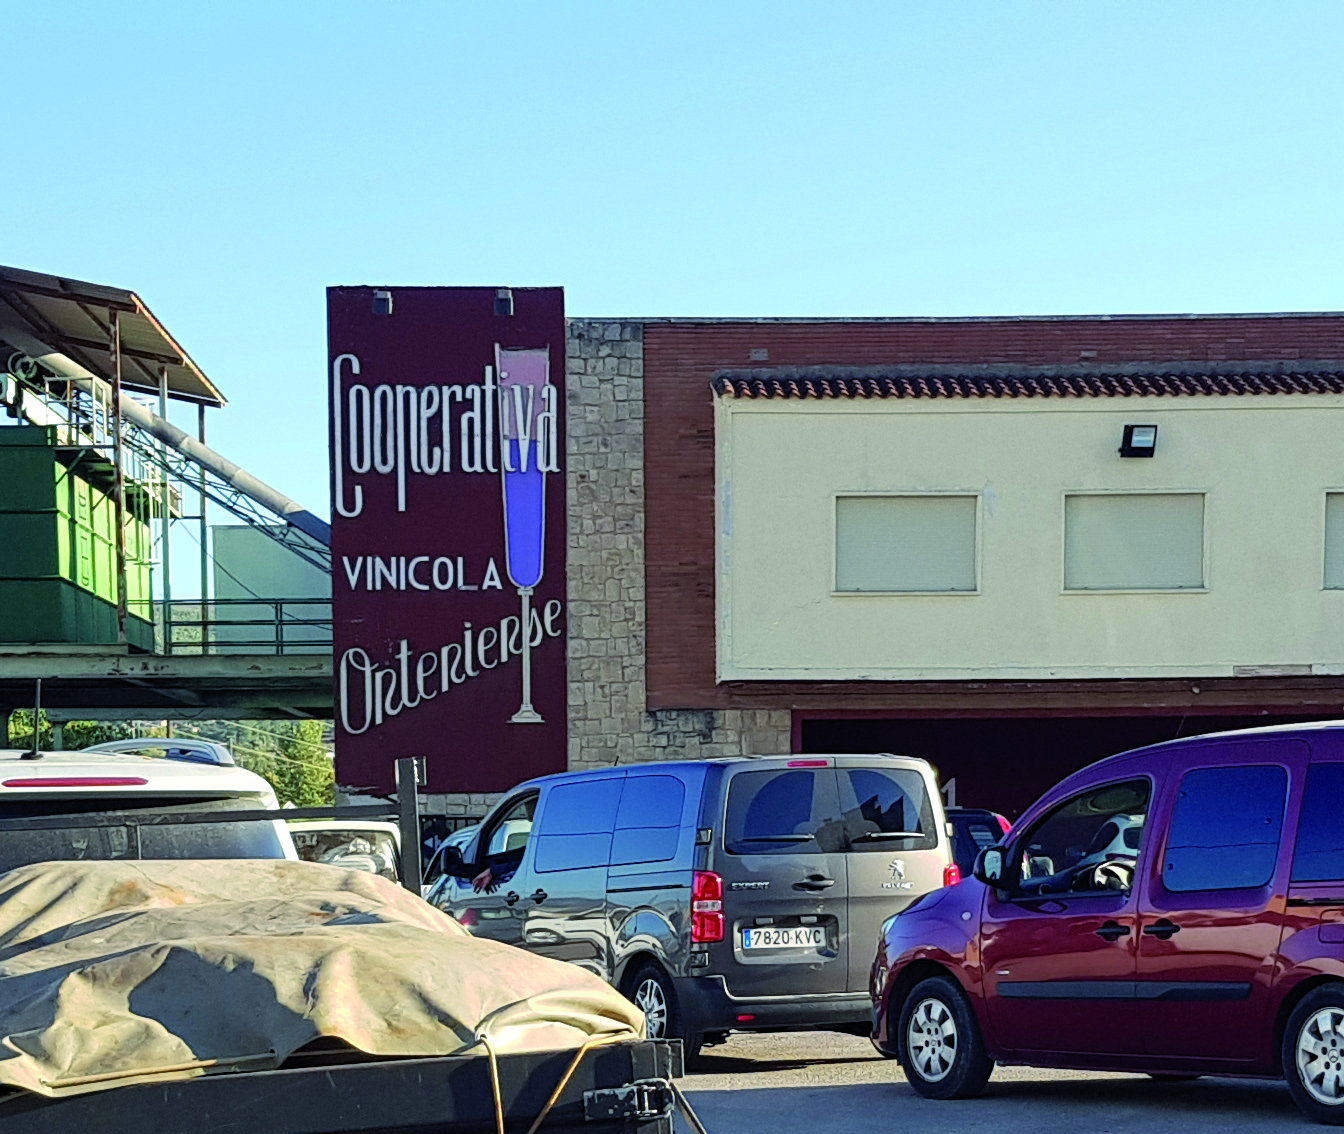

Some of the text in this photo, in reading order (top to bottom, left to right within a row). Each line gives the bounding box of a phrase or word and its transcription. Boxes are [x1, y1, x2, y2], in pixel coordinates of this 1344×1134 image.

[333, 353, 561, 518] Cooperativa
[342, 555, 503, 592] VINICOLA
[940, 777, 963, 810] 1
[753, 929, 822, 946] 7820 KVC
